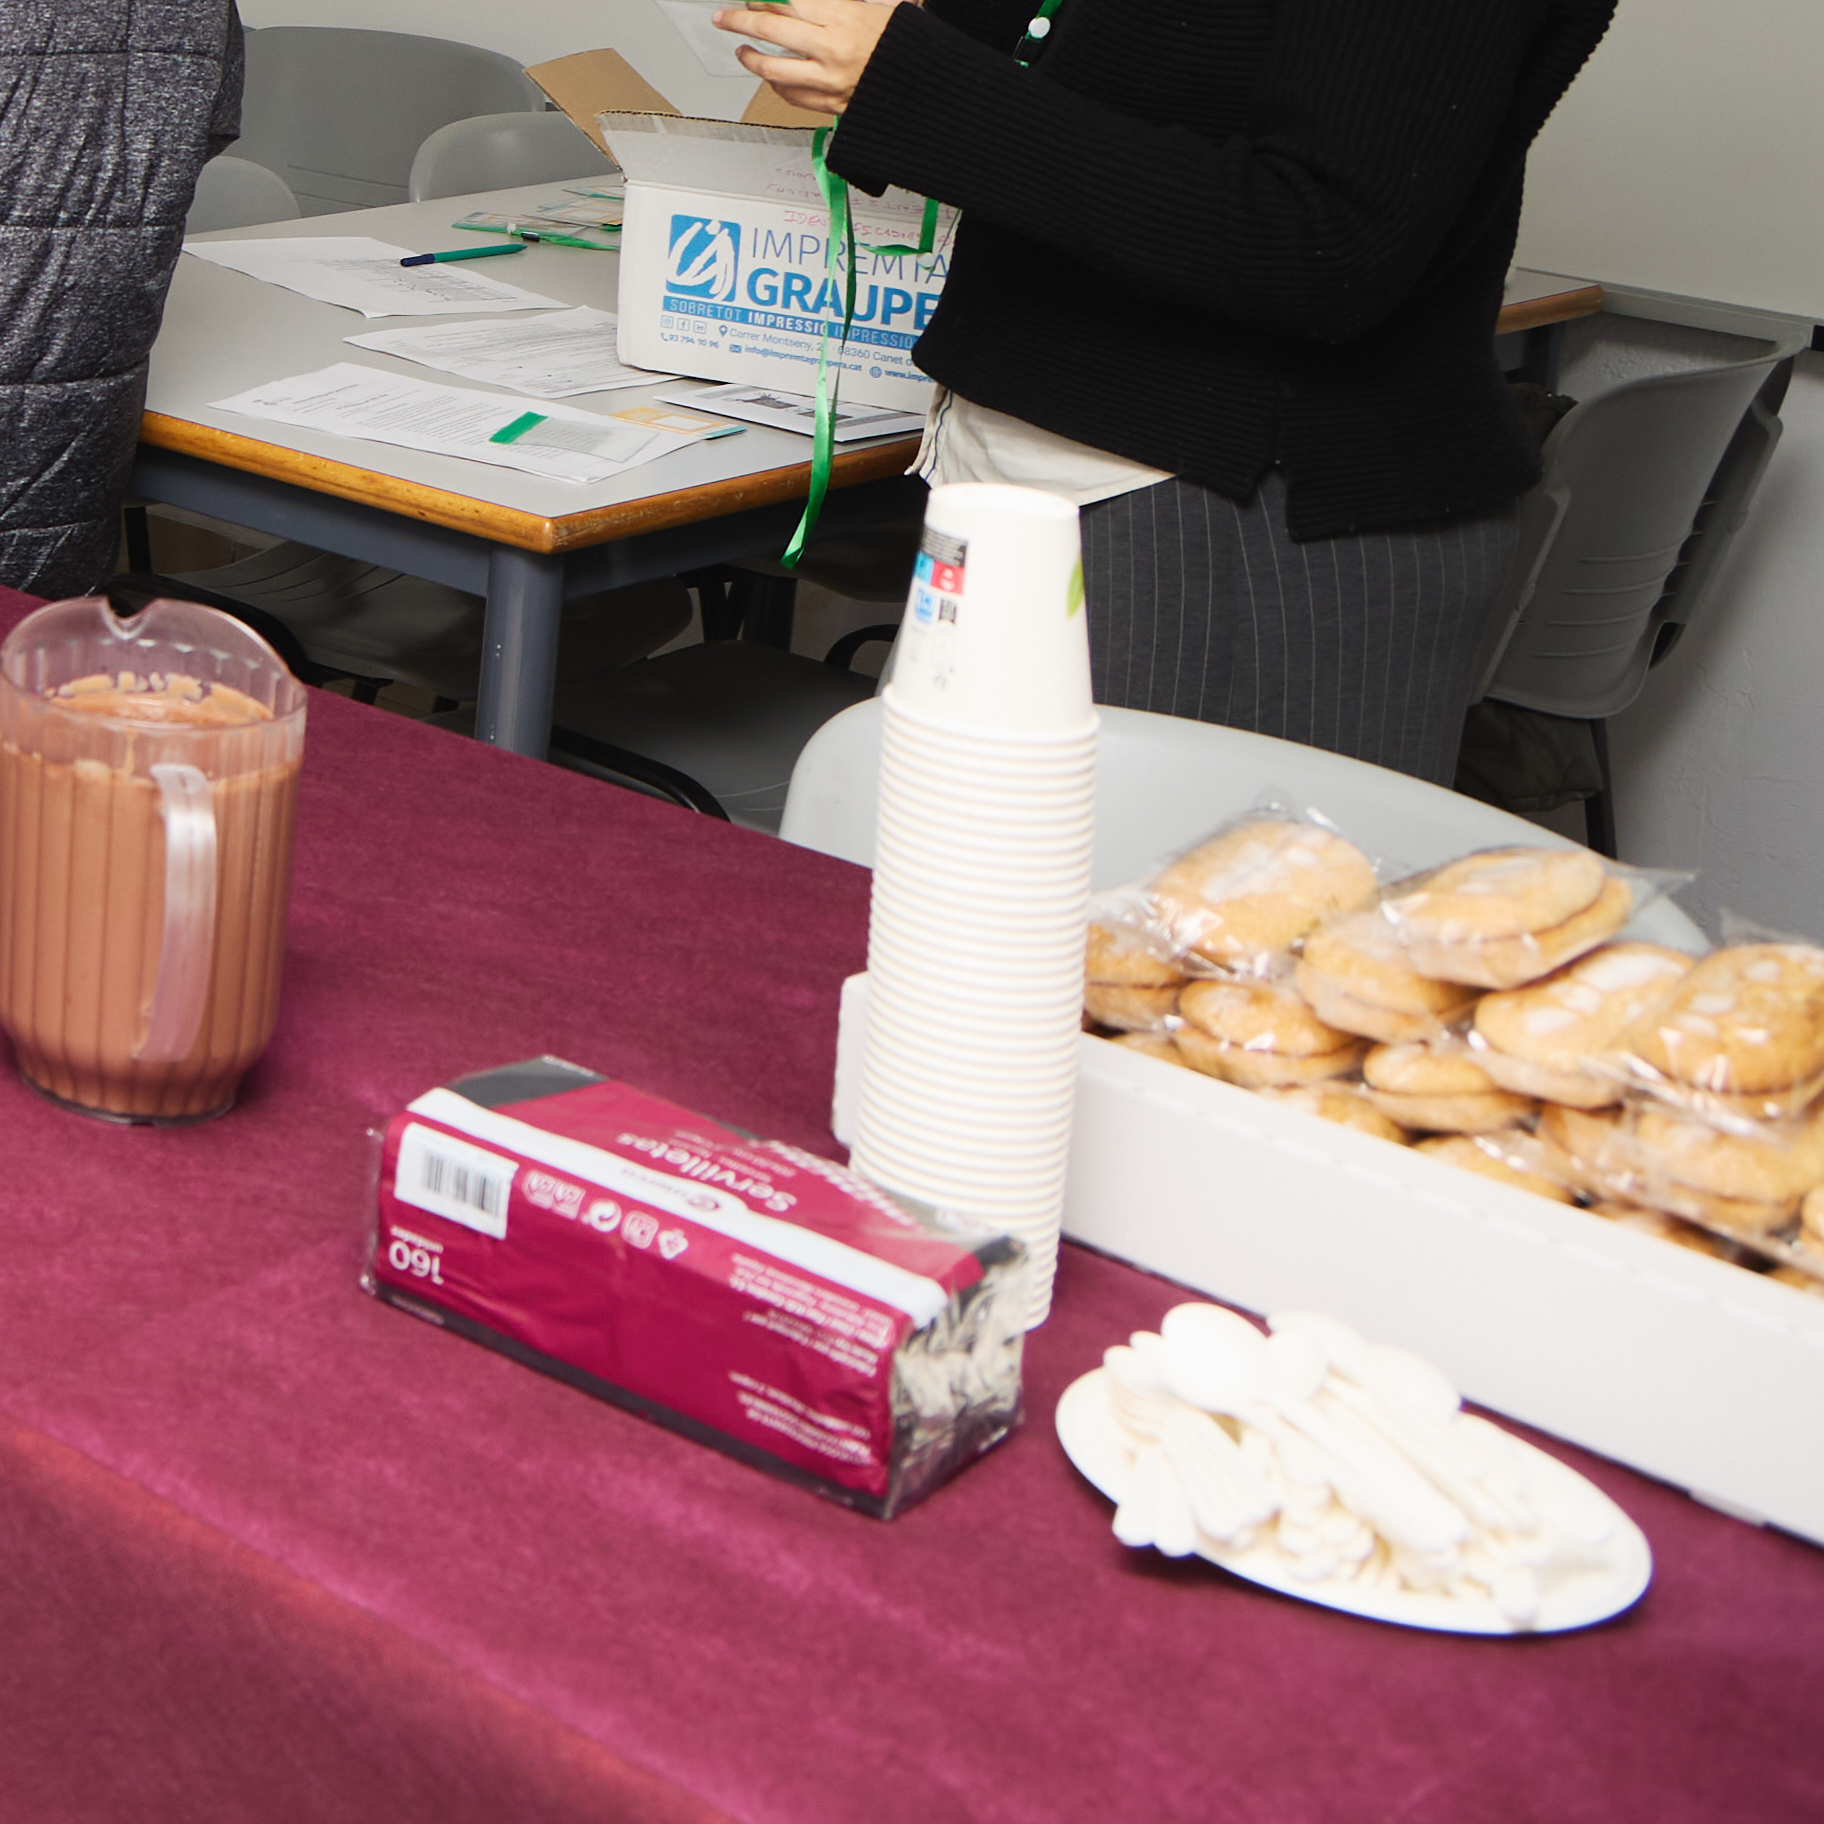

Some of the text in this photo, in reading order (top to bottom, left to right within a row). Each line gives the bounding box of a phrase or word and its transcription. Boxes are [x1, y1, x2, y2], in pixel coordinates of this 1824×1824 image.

[669, 298, 743, 322] SOBRETOT
[746, 267, 941, 331] GRAUPE
[873, 351, 903, 366] Canet
[388, 1240, 445, 1286] 160
